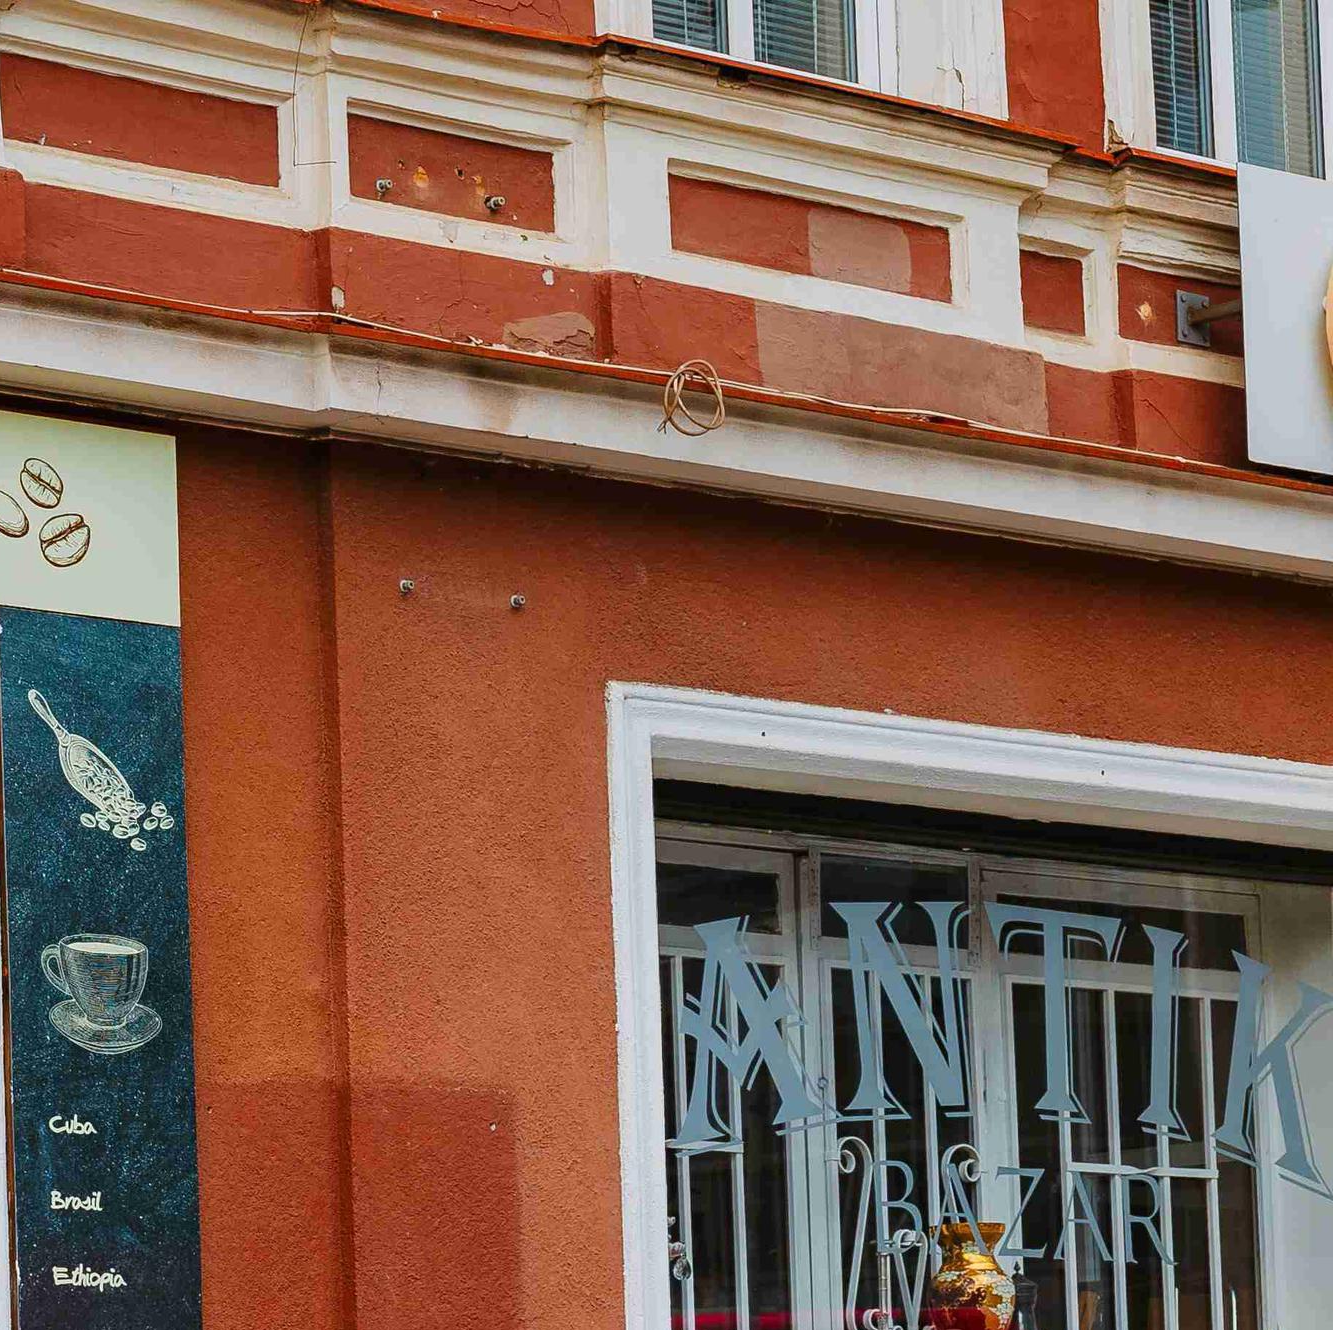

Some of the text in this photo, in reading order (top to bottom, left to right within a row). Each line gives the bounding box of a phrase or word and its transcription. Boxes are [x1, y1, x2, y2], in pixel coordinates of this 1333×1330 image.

[675, 899, 1333, 1199] ANTIK
[48, 1114, 97, 1135] Cuba
[50, 1190, 103, 1212] Brasil
[874, 1159, 1178, 1266] BAZAR
[52, 1263, 128, 1292] Ethiopia
